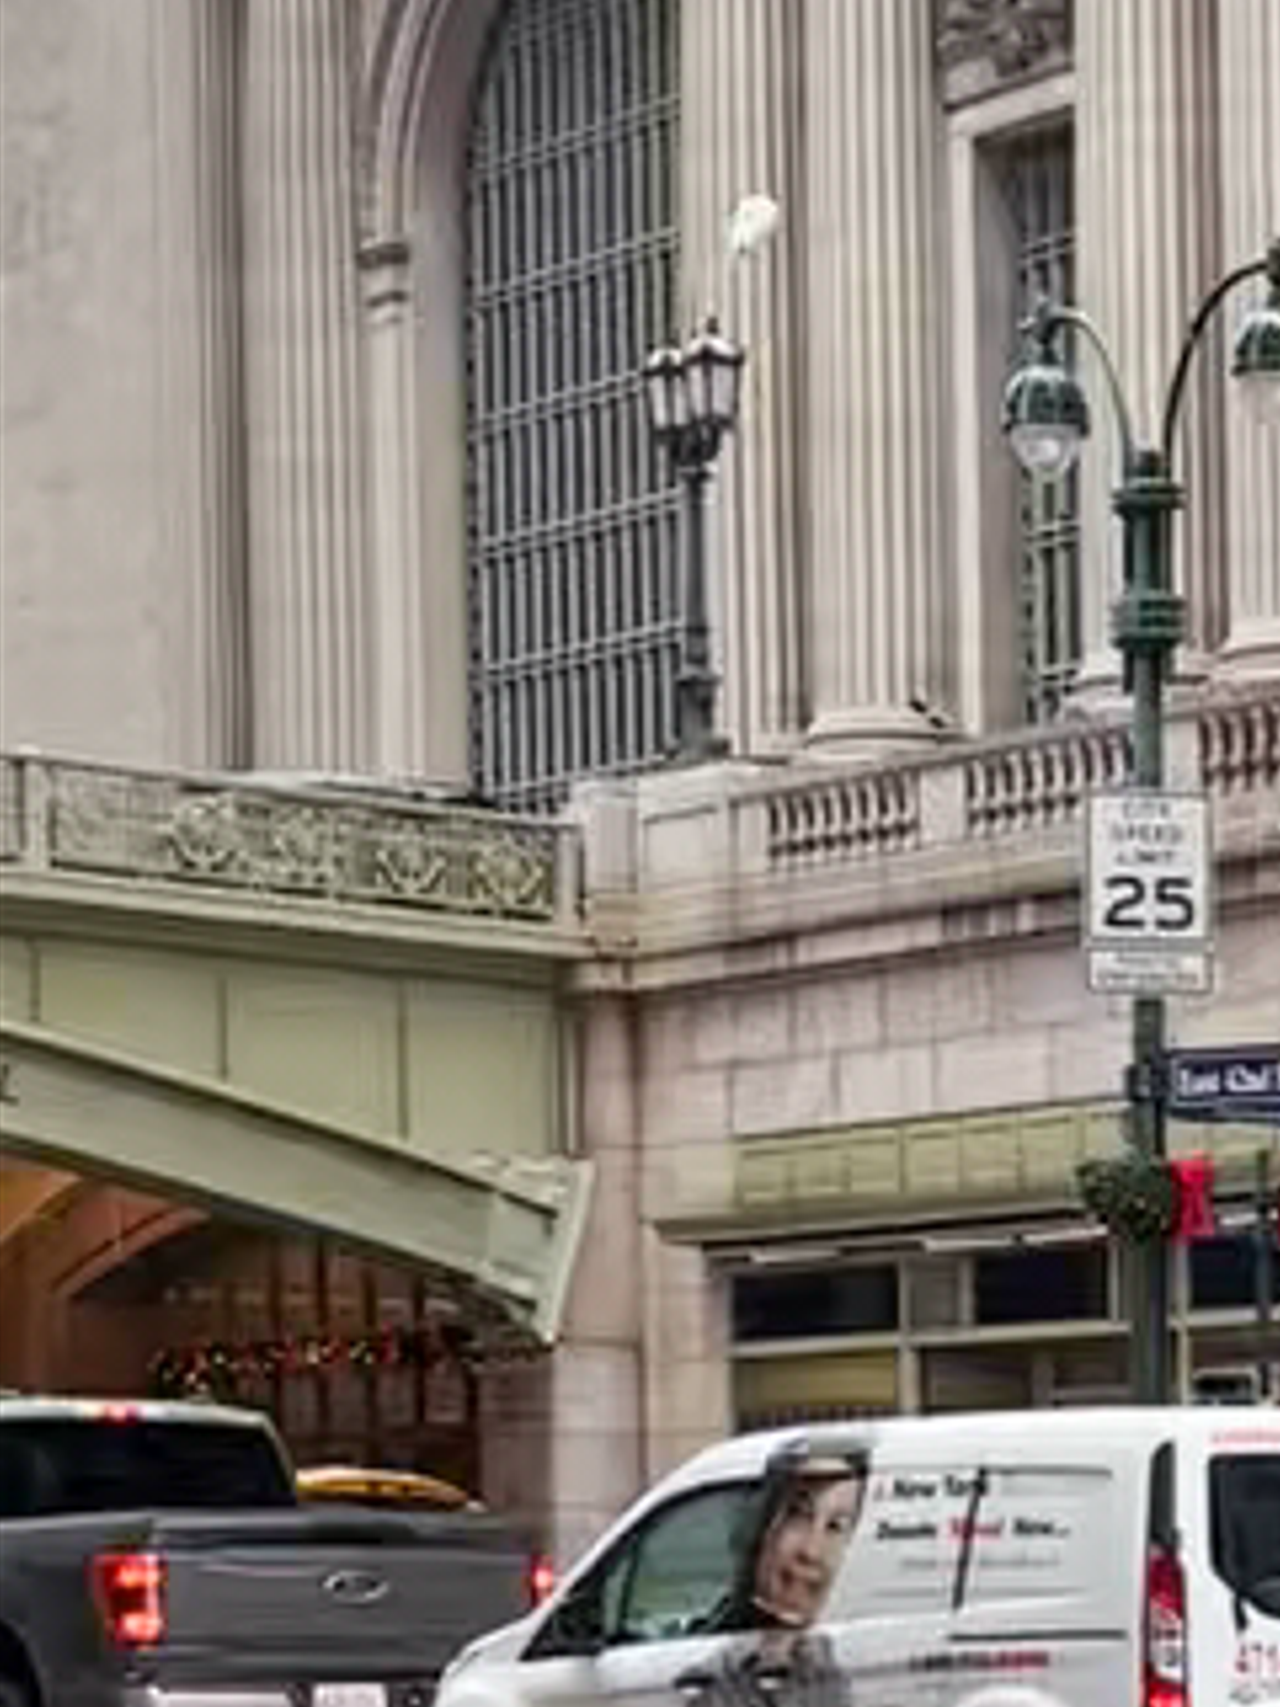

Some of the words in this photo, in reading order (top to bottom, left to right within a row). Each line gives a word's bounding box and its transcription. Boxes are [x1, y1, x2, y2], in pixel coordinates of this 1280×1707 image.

[1110, 822, 1183, 844] SPEED
[1115, 849, 1178, 866] LIMIT
[1104, 876, 1195, 931] 25
